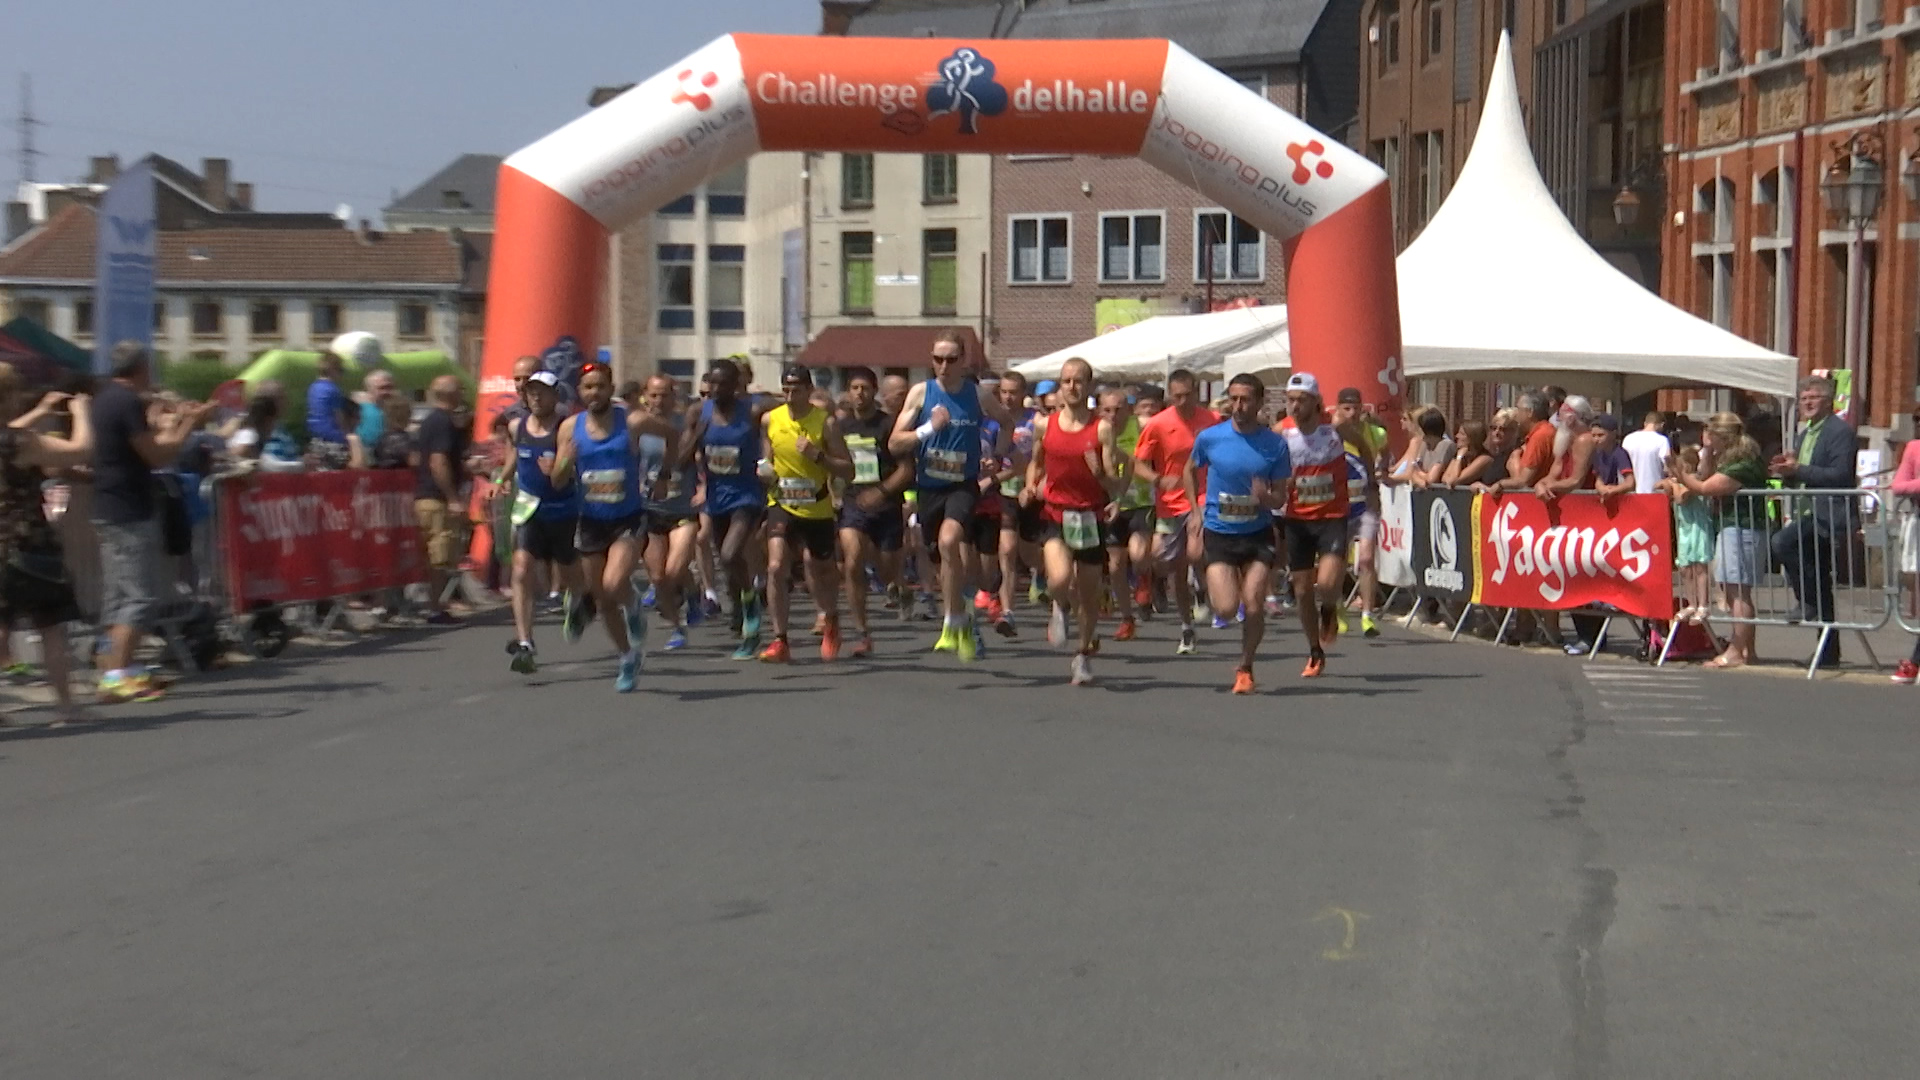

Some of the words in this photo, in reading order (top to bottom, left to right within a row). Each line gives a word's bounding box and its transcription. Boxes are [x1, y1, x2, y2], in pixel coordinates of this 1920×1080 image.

[757, 72, 917, 114] Challenge
[1014, 80, 1147, 113] delhalle
[1154, 117, 1317, 217] joggingplus
